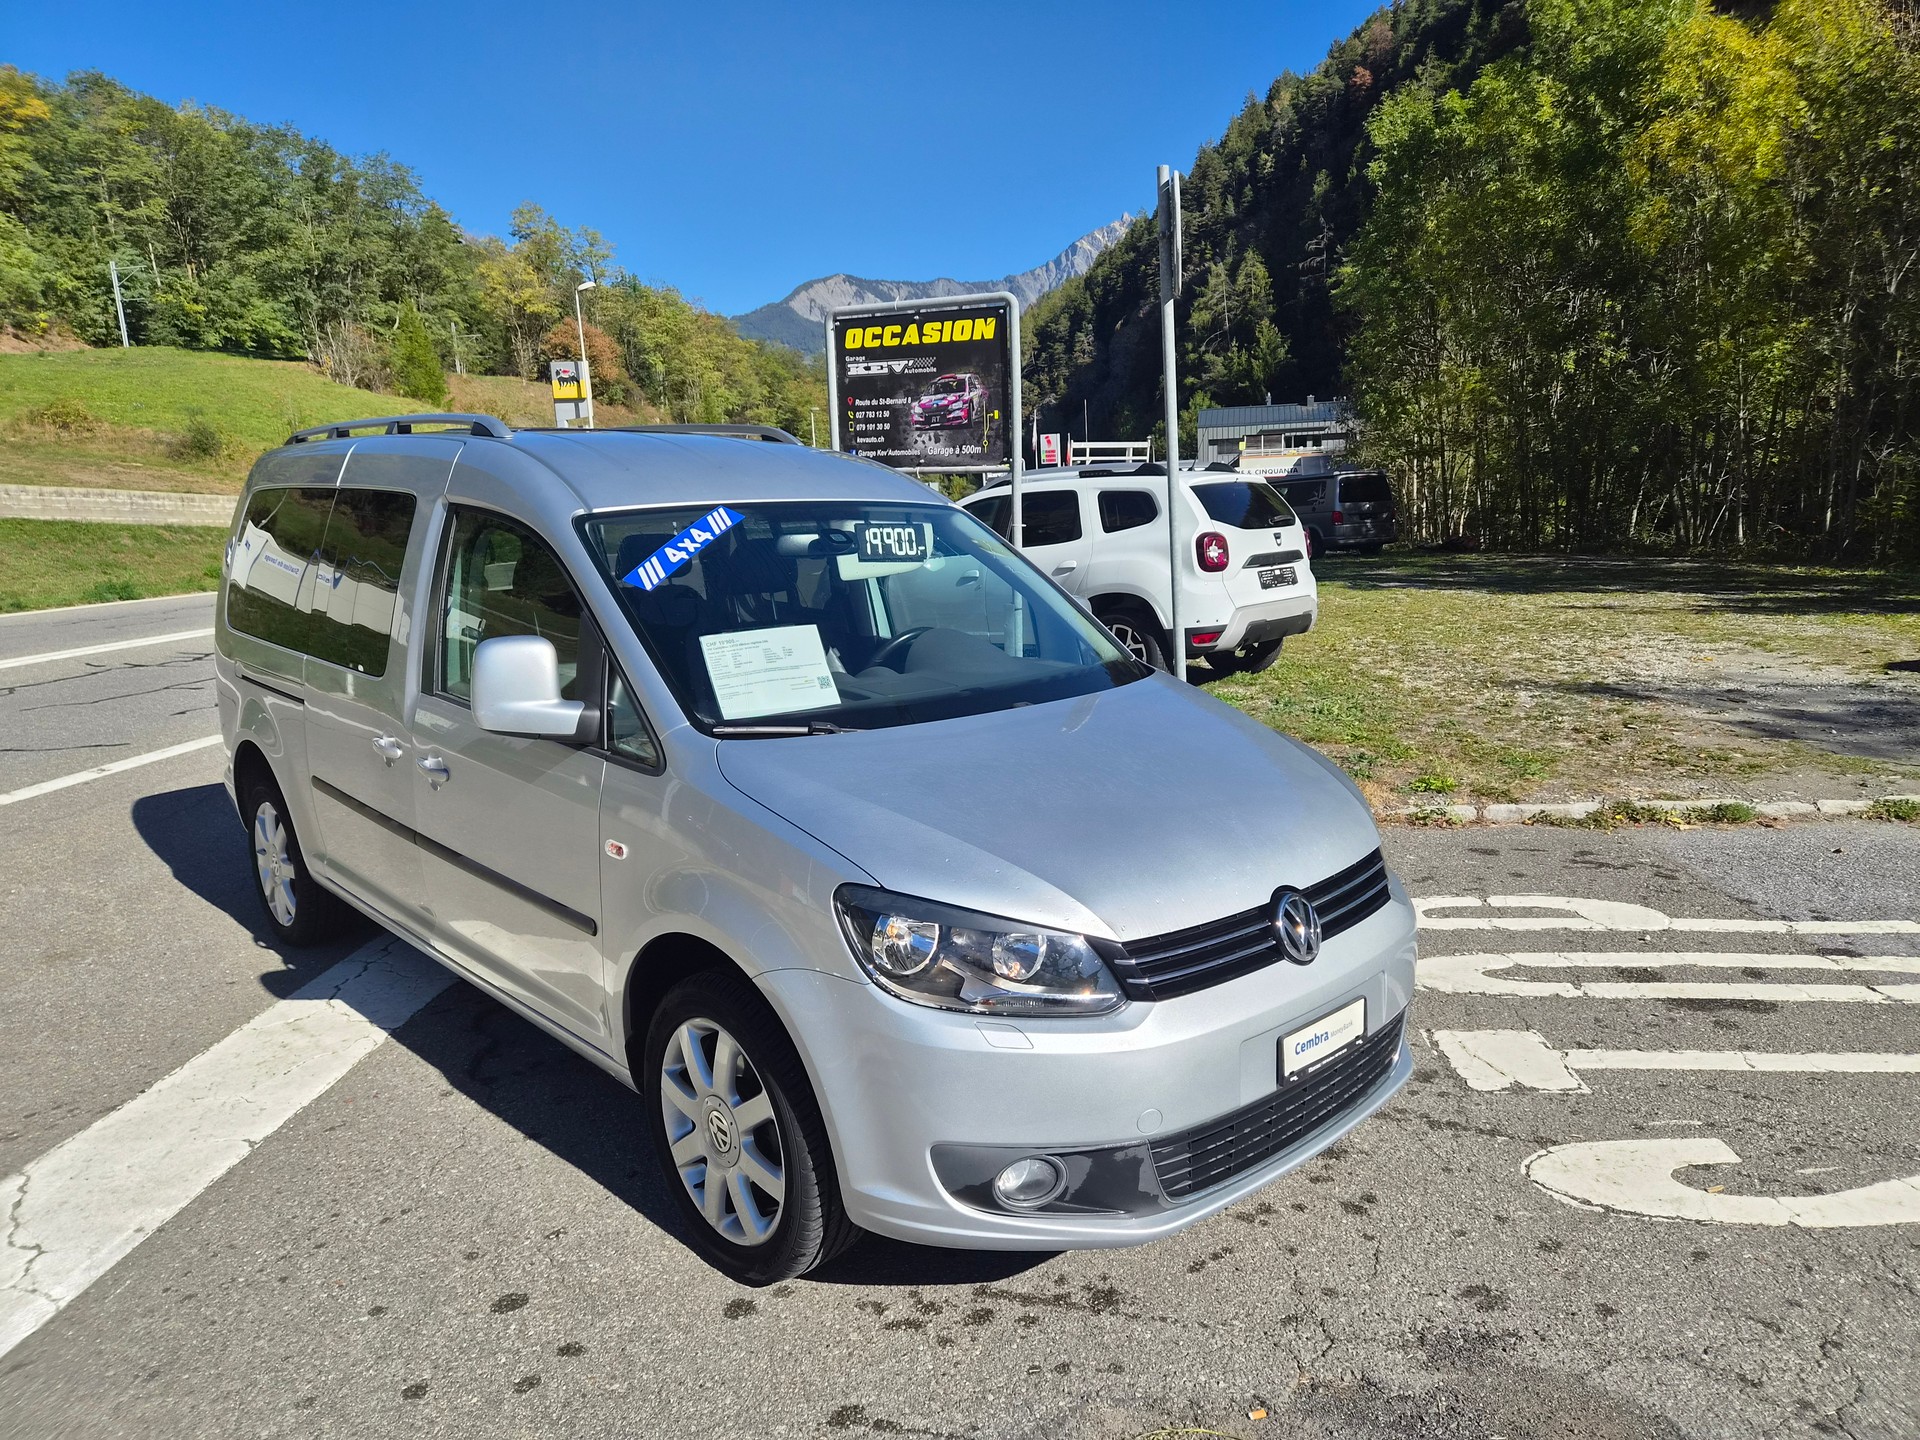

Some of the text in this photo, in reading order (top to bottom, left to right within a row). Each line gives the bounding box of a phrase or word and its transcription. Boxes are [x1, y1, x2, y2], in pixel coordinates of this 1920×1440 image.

[845, 318, 996, 349] OCCASION
[879, 397, 907, 405] St-Bernard
[855, 411, 865, 419] 027
[883, 410, 890, 418] 50
[856, 423, 866, 431] 079
[867, 423, 876, 431] 101
[857, 436, 885, 444] kevauto.ch
[858, 450, 876, 458] Garage
[927, 445, 982, 457] Garage à 500m
[1254, 467, 1299, 475] CINQUANTA
[664, 528, 714, 563] 4x4
[1294, 1020, 1353, 1055] Cembra MoneyBank
